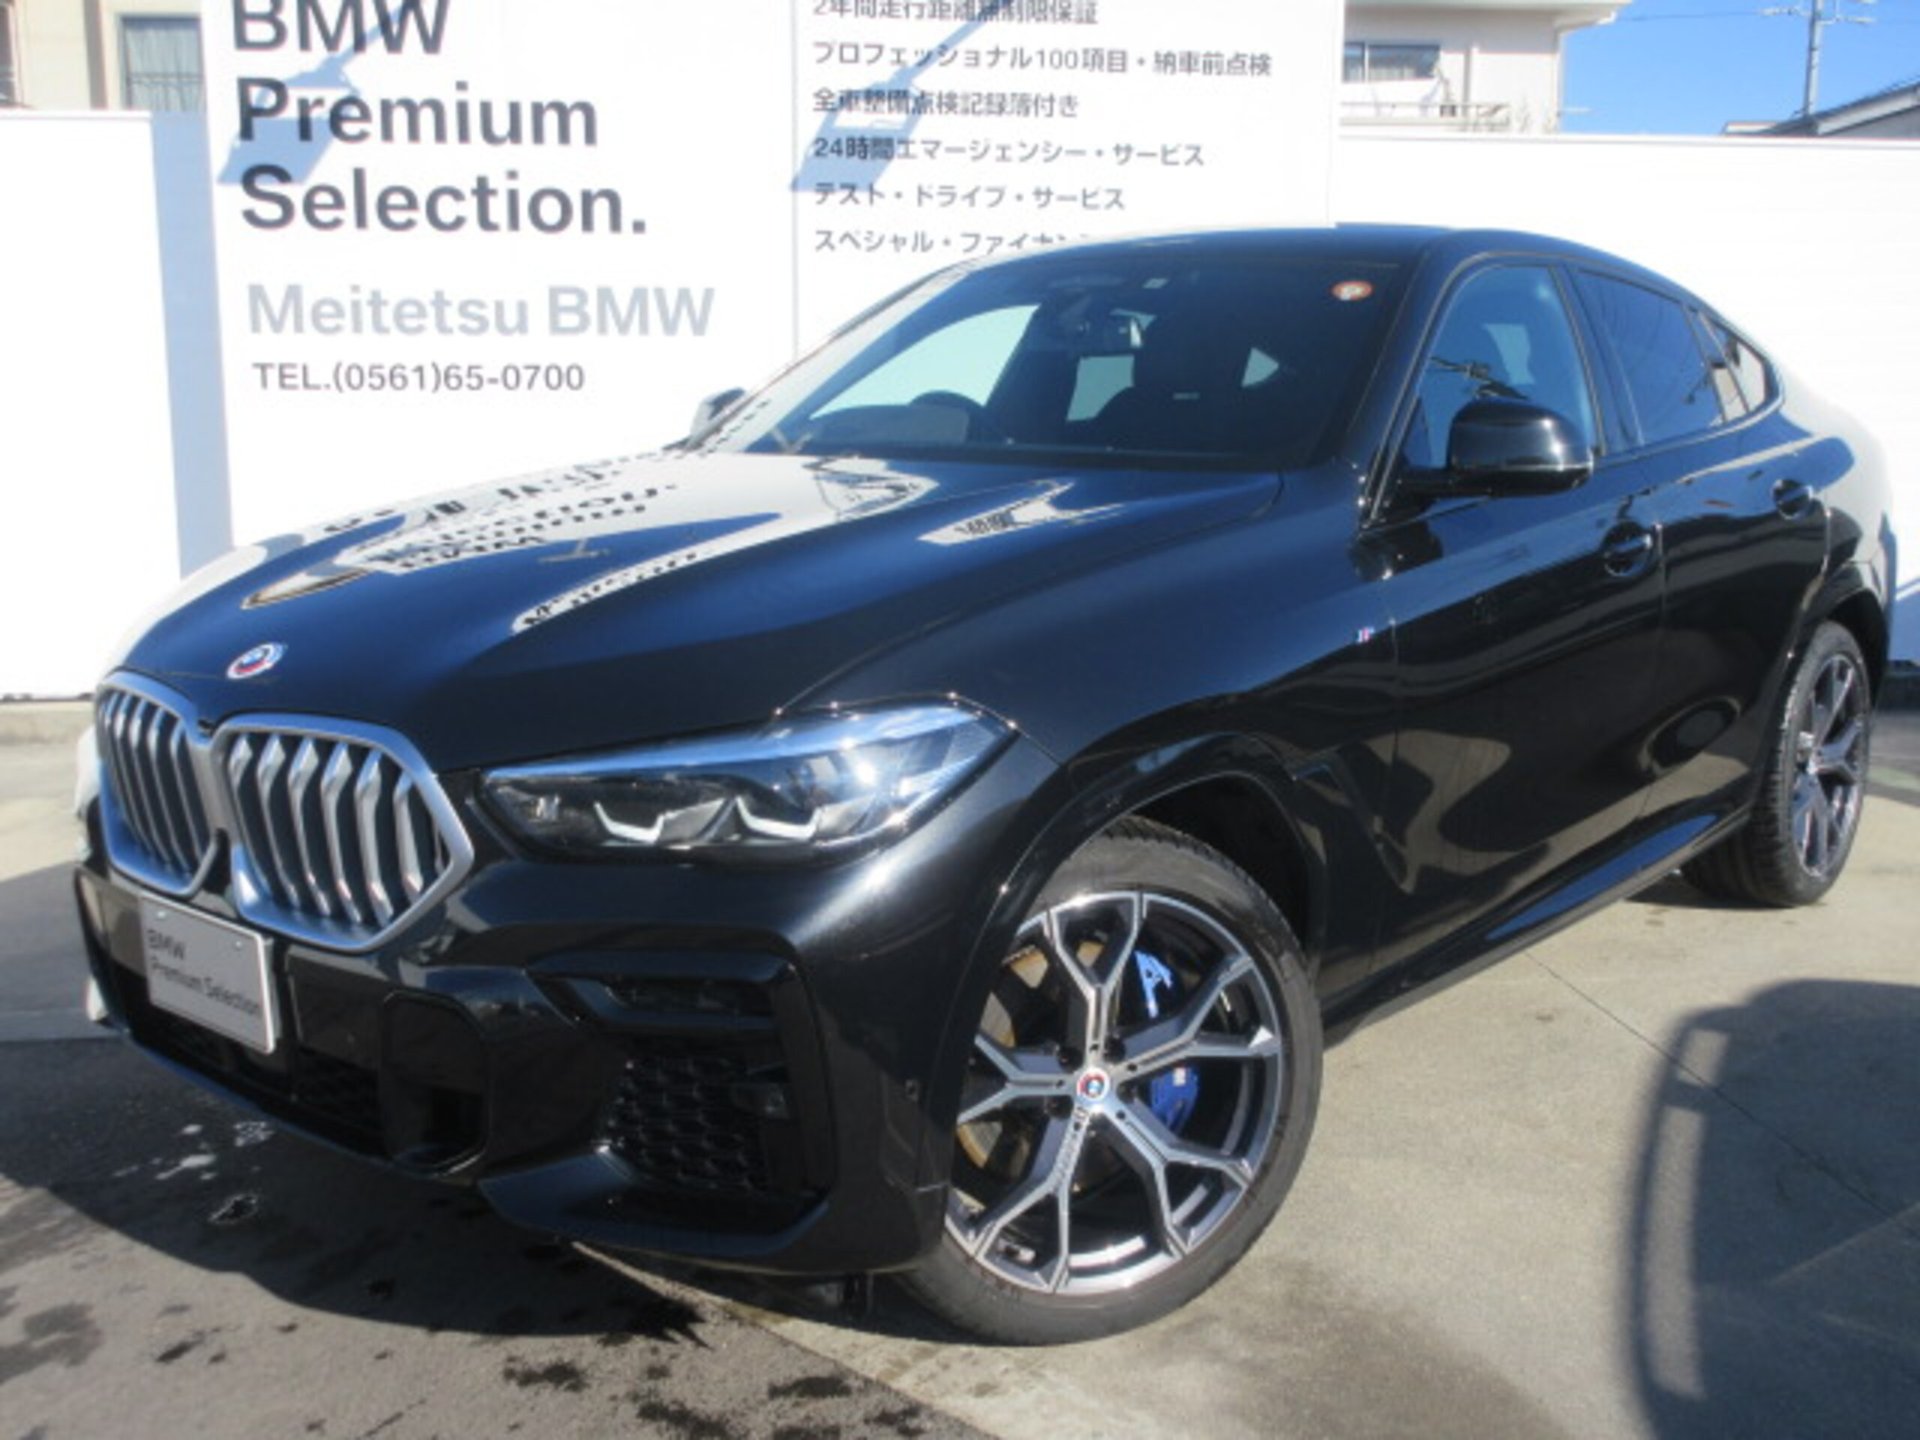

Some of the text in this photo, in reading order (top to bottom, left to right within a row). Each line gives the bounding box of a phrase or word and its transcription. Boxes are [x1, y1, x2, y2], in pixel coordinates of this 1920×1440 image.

[232, 0, 449, 54] BMW
[236, 77, 598, 146] Premium
[240, 163, 647, 234] Selection.
[246, 282, 715, 337] Meitetsu BMW
[252, 361, 585, 393] TEL.(0561)65-0700
